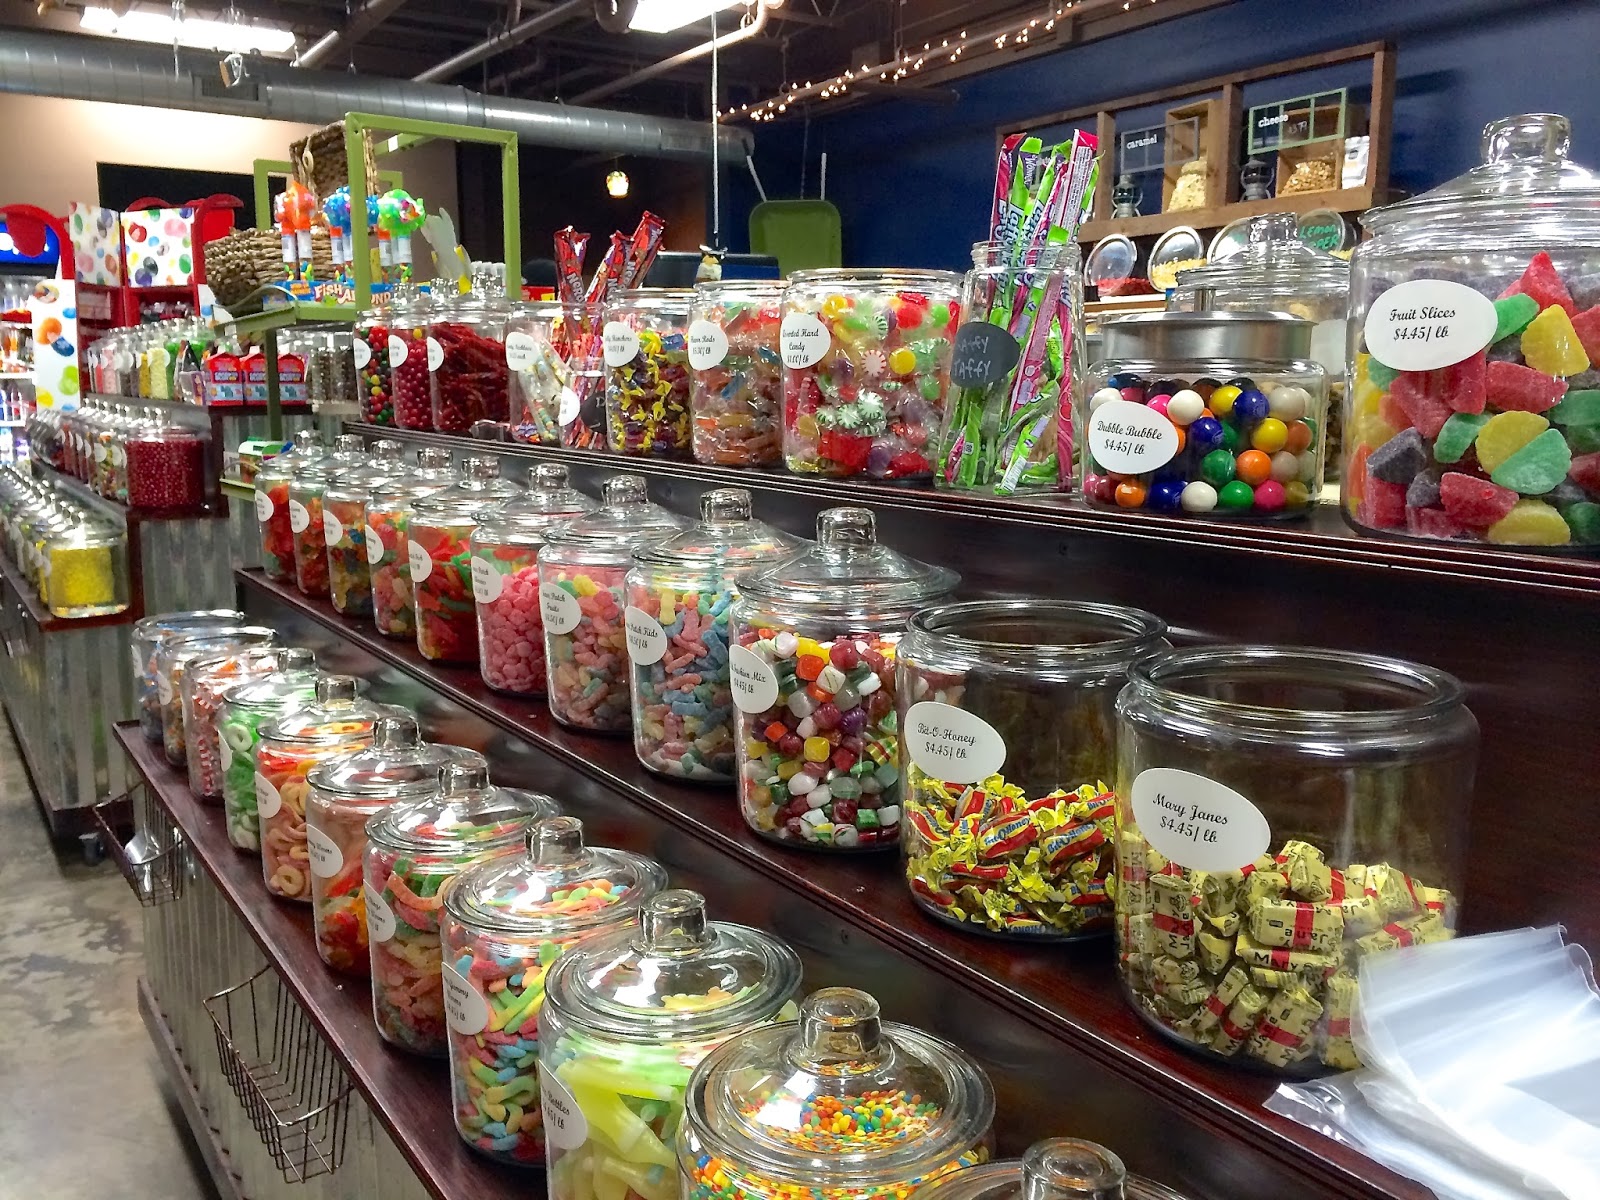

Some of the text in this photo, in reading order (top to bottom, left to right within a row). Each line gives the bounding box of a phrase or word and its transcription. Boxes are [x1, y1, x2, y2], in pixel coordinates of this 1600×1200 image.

[1258, 114, 1289, 128] cheese
[1126, 133, 1157, 150] caramel
[1389, 306, 1456, 321] Fruit Slices
[800, 328, 819, 338] Hard
[1393, 325, 1449, 342] $4.45/ lb
[1097, 420, 1163, 441] Dubble Bubble
[1104, 438, 1145, 456] $4.45/ lb
[751, 671, 767, 683] Mix
[917, 722, 976, 747] Bit-O-Honey
[925, 741, 953, 761] $4.45/
[1152, 793, 1229, 826] Mary Janes
[1160, 815, 1218, 843] $4.45/ lb
